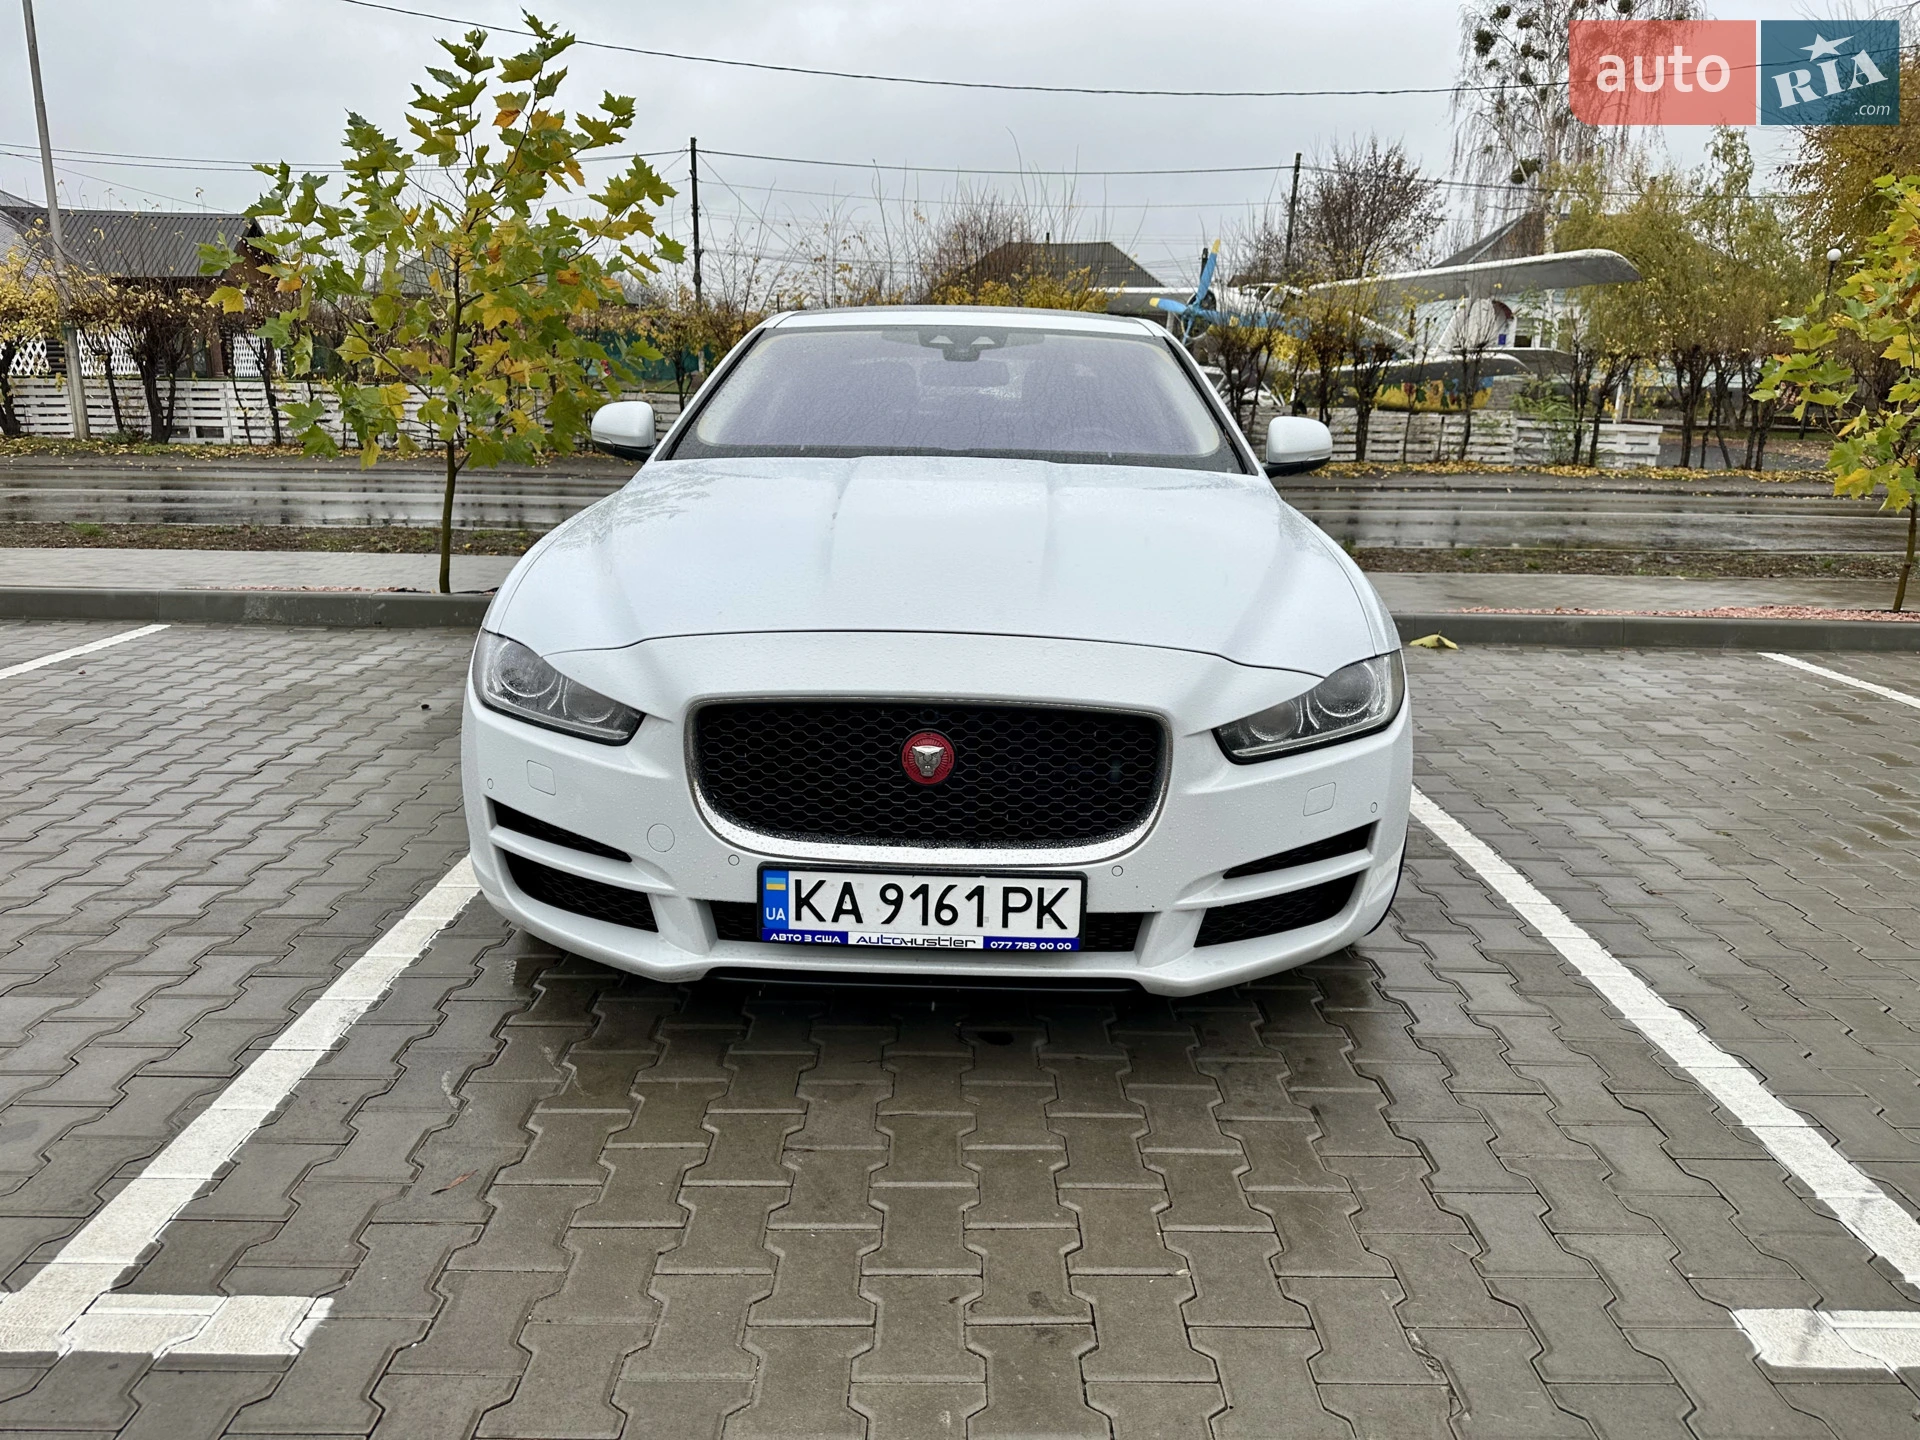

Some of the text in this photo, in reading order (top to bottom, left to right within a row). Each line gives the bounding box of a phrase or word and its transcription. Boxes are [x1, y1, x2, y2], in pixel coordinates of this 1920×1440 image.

[794, 879, 1070, 930] KA 9161 PK
[765, 907, 786, 921] UA
[769, 932, 802, 942] АВТО
[814, 934, 842, 944] США
[990, 941, 1072, 950] 077 789 00 00
